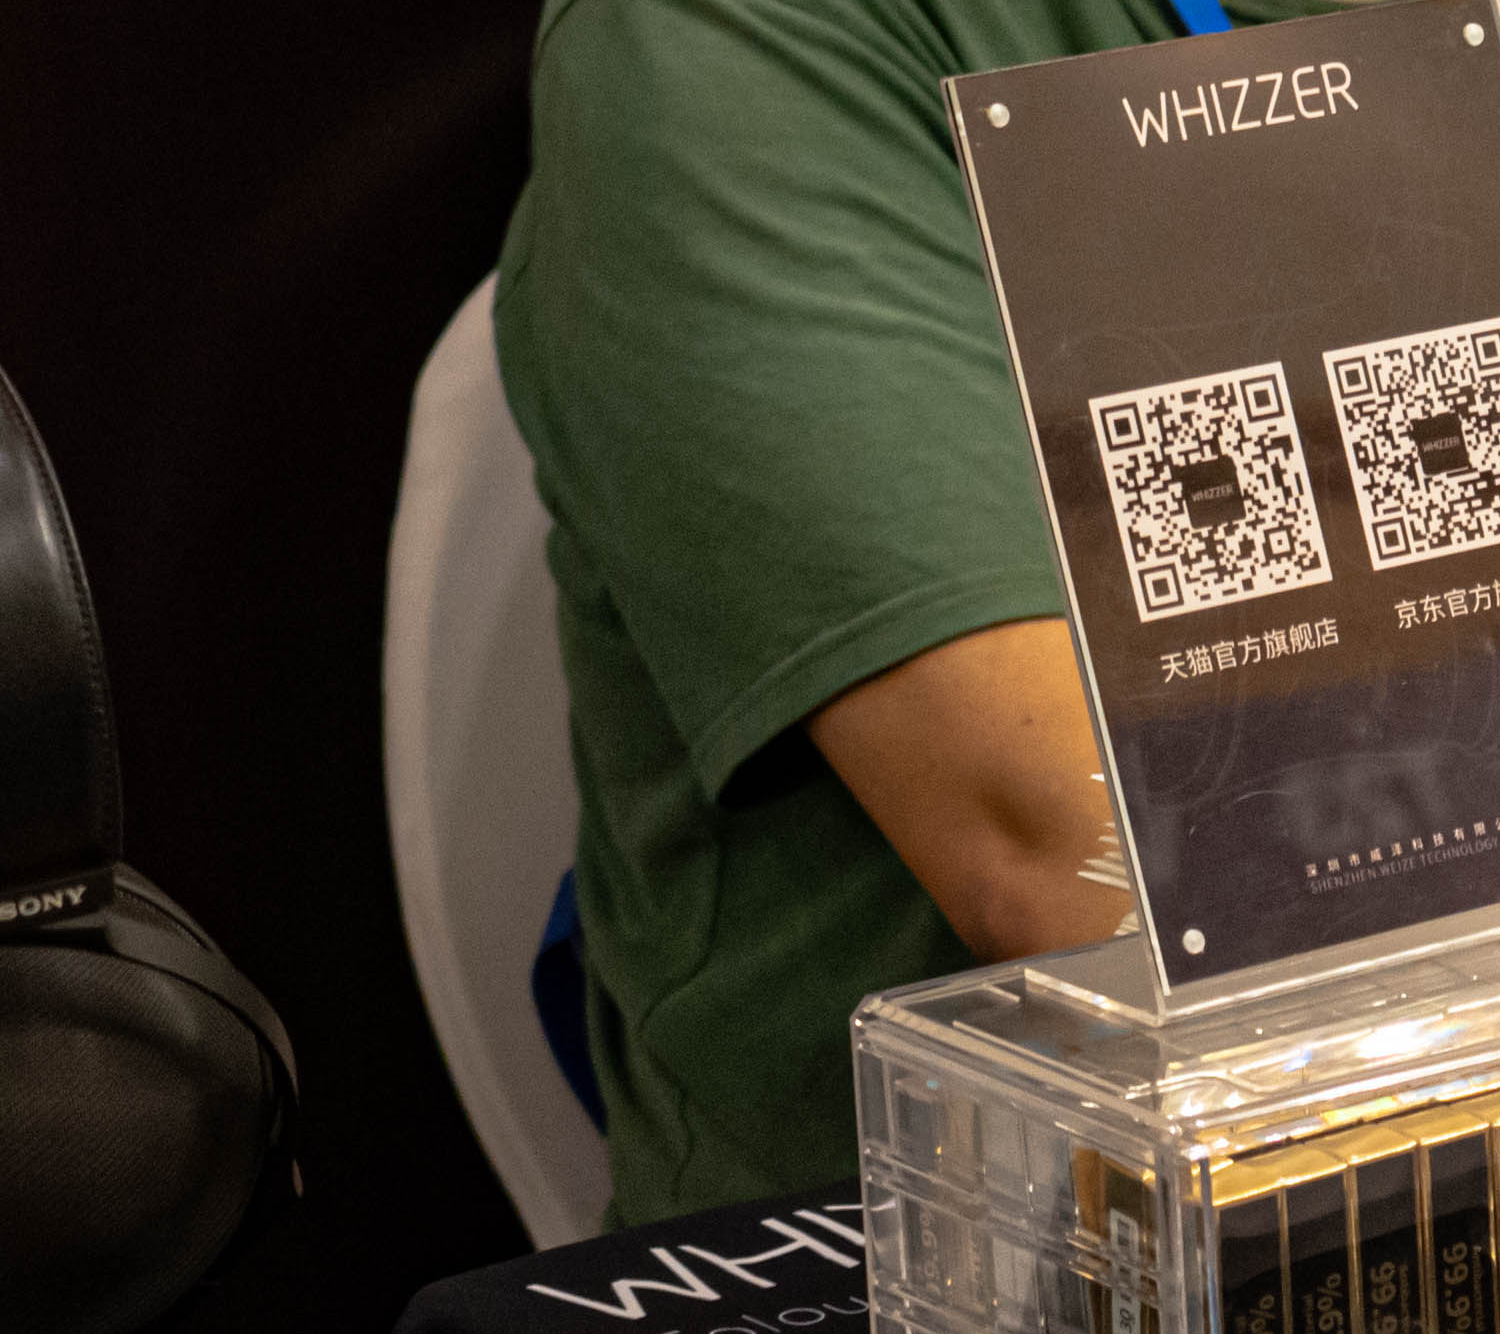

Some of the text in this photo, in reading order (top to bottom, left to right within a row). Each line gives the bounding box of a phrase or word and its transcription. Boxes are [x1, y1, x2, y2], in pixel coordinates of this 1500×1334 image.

[1122, 60, 1360, 147] WHIZZER
[1160, 617, 1341, 683] 天猫官方旗舰店
